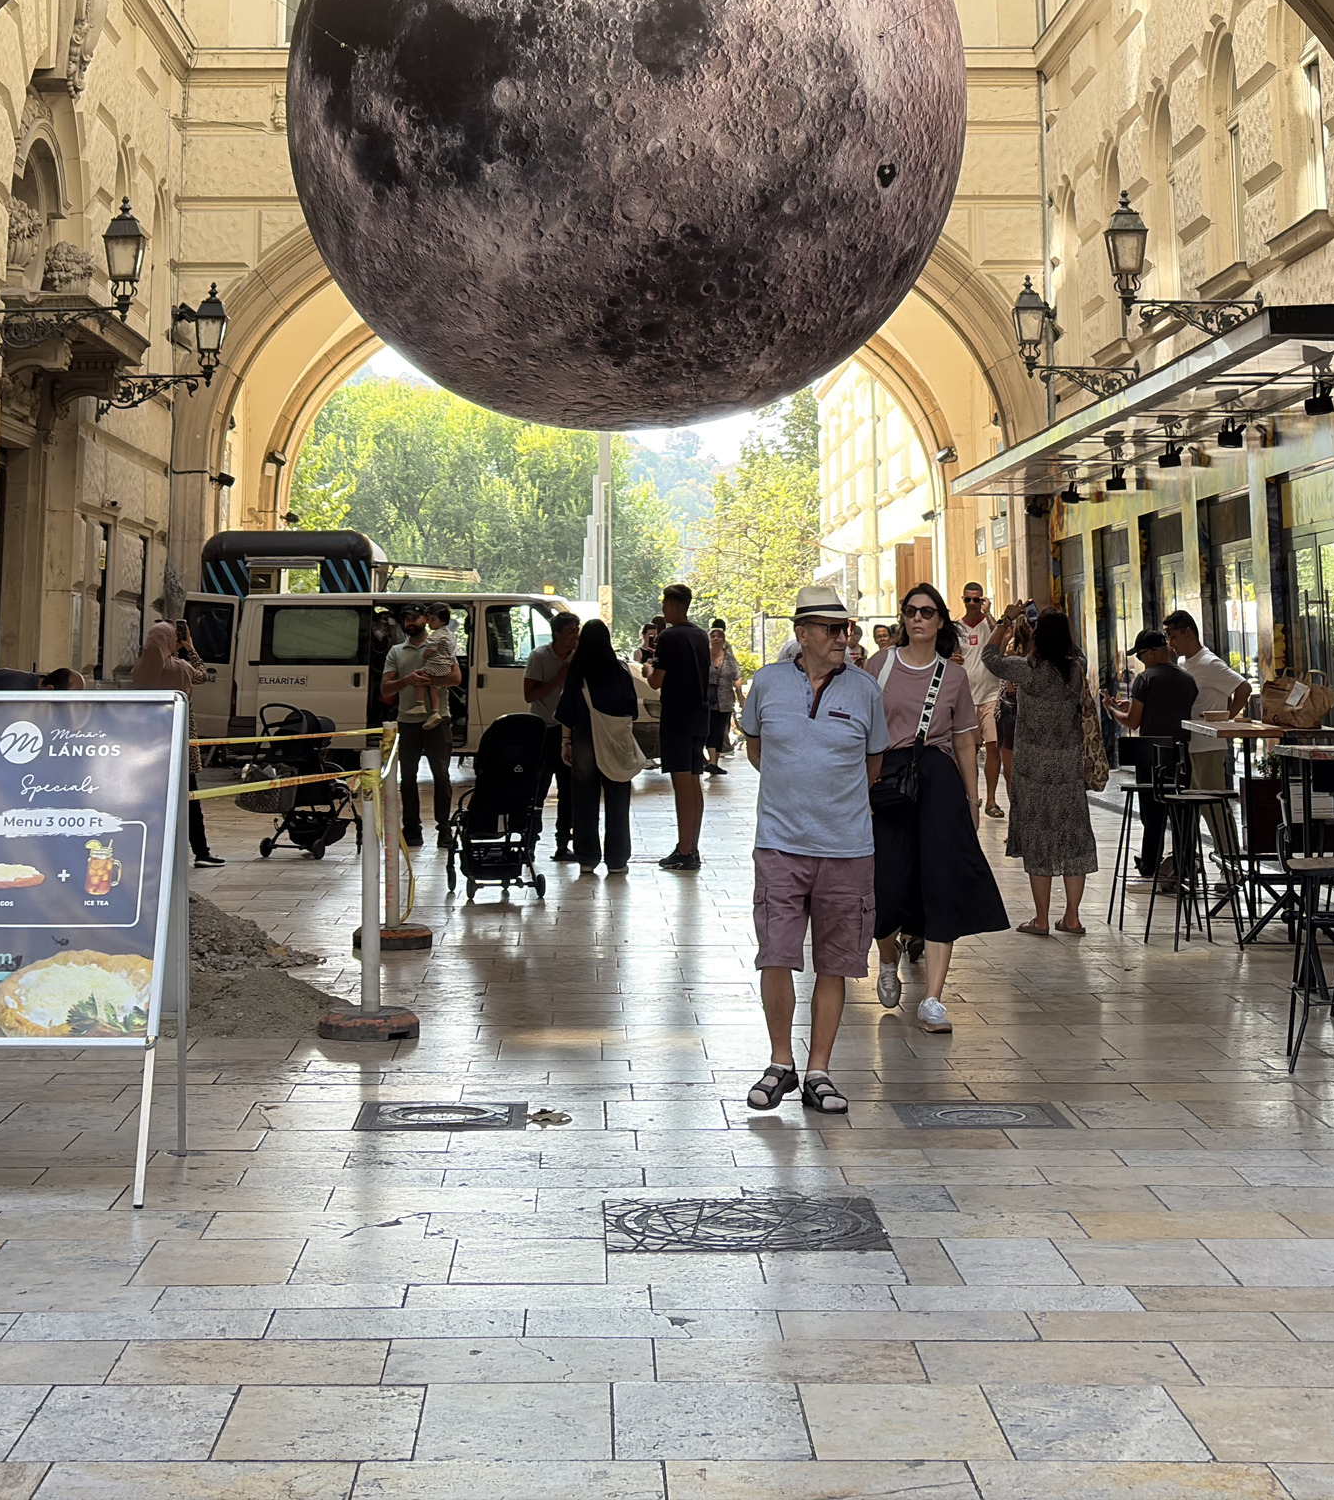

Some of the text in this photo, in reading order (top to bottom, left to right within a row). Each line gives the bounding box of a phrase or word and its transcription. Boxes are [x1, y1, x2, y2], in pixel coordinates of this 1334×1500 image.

[48, 742, 121, 757] LÁNGOS
[20, 773, 100, 802] Specials
[3, 816, 42, 827] Menu
[89, 816, 103, 827] Ft
